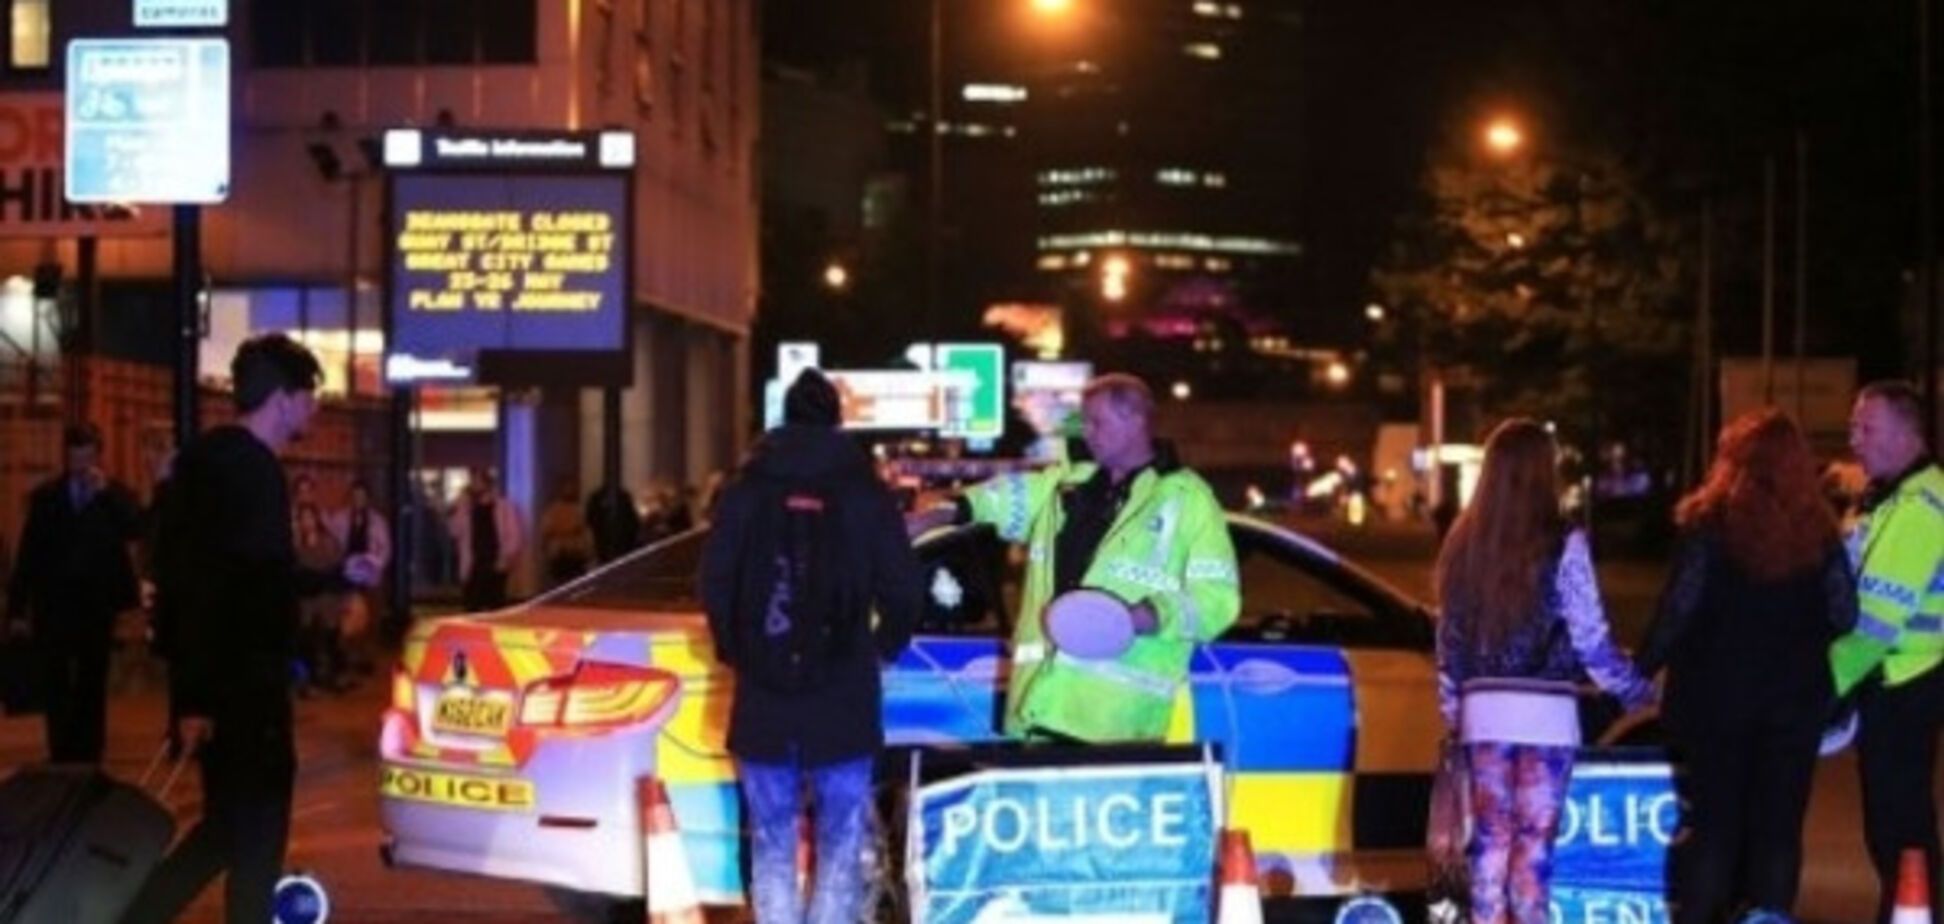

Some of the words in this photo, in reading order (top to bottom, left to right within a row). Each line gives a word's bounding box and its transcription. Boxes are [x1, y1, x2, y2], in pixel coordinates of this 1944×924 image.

[481, 253, 532, 270] CITY
[409, 291, 463, 309] PLAN
[378, 767, 530, 806] POLICE
[942, 792, 1188, 858] POLICE
[1553, 790, 1678, 846] OLIC
